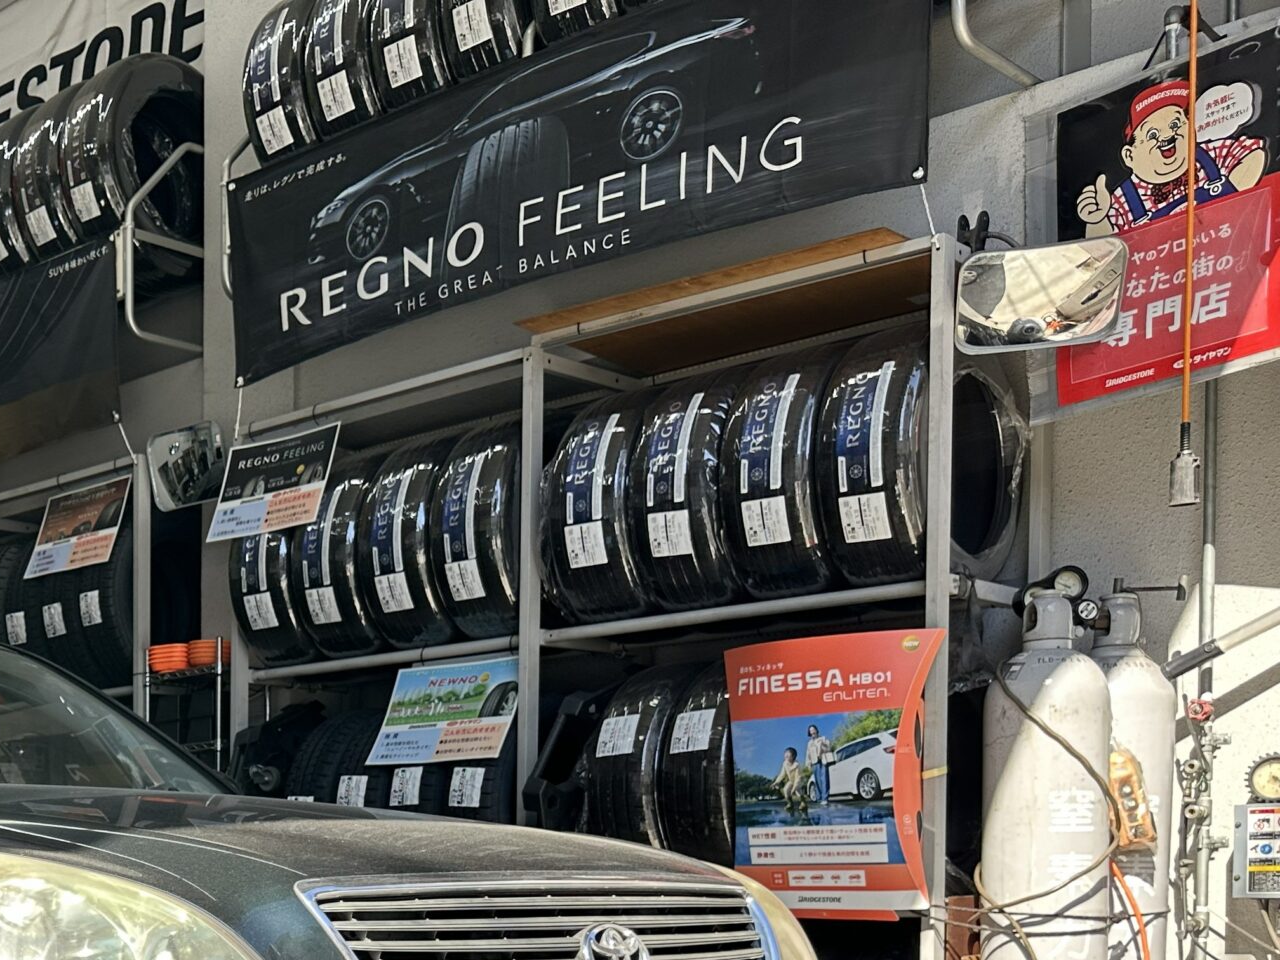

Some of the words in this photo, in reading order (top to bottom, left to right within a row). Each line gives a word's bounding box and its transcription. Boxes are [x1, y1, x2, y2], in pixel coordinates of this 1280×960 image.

[257, 19, 273, 76] RENO
[1135, 88, 1190, 112] BRIDGESTONE
[279, 221, 485, 332] REGNO
[518, 116, 803, 247] FEELING
[394, 292, 427, 315] THE
[519, 228, 631, 274] BALANCE
[1100, 281, 1233, 348] 専門店
[1105, 367, 1156, 388] BRIDGESTONE
[749, 382, 777, 454] REGNO
[845, 371, 870, 448] REGNO
[238, 453, 280, 470] REGNO
[282, 441, 325, 460] FEELING
[448, 461, 469, 527] REGNO
[428, 675, 478, 688] NEWNO
[738, 668, 844, 697] FINESSA
[848, 671, 892, 686] HB01
